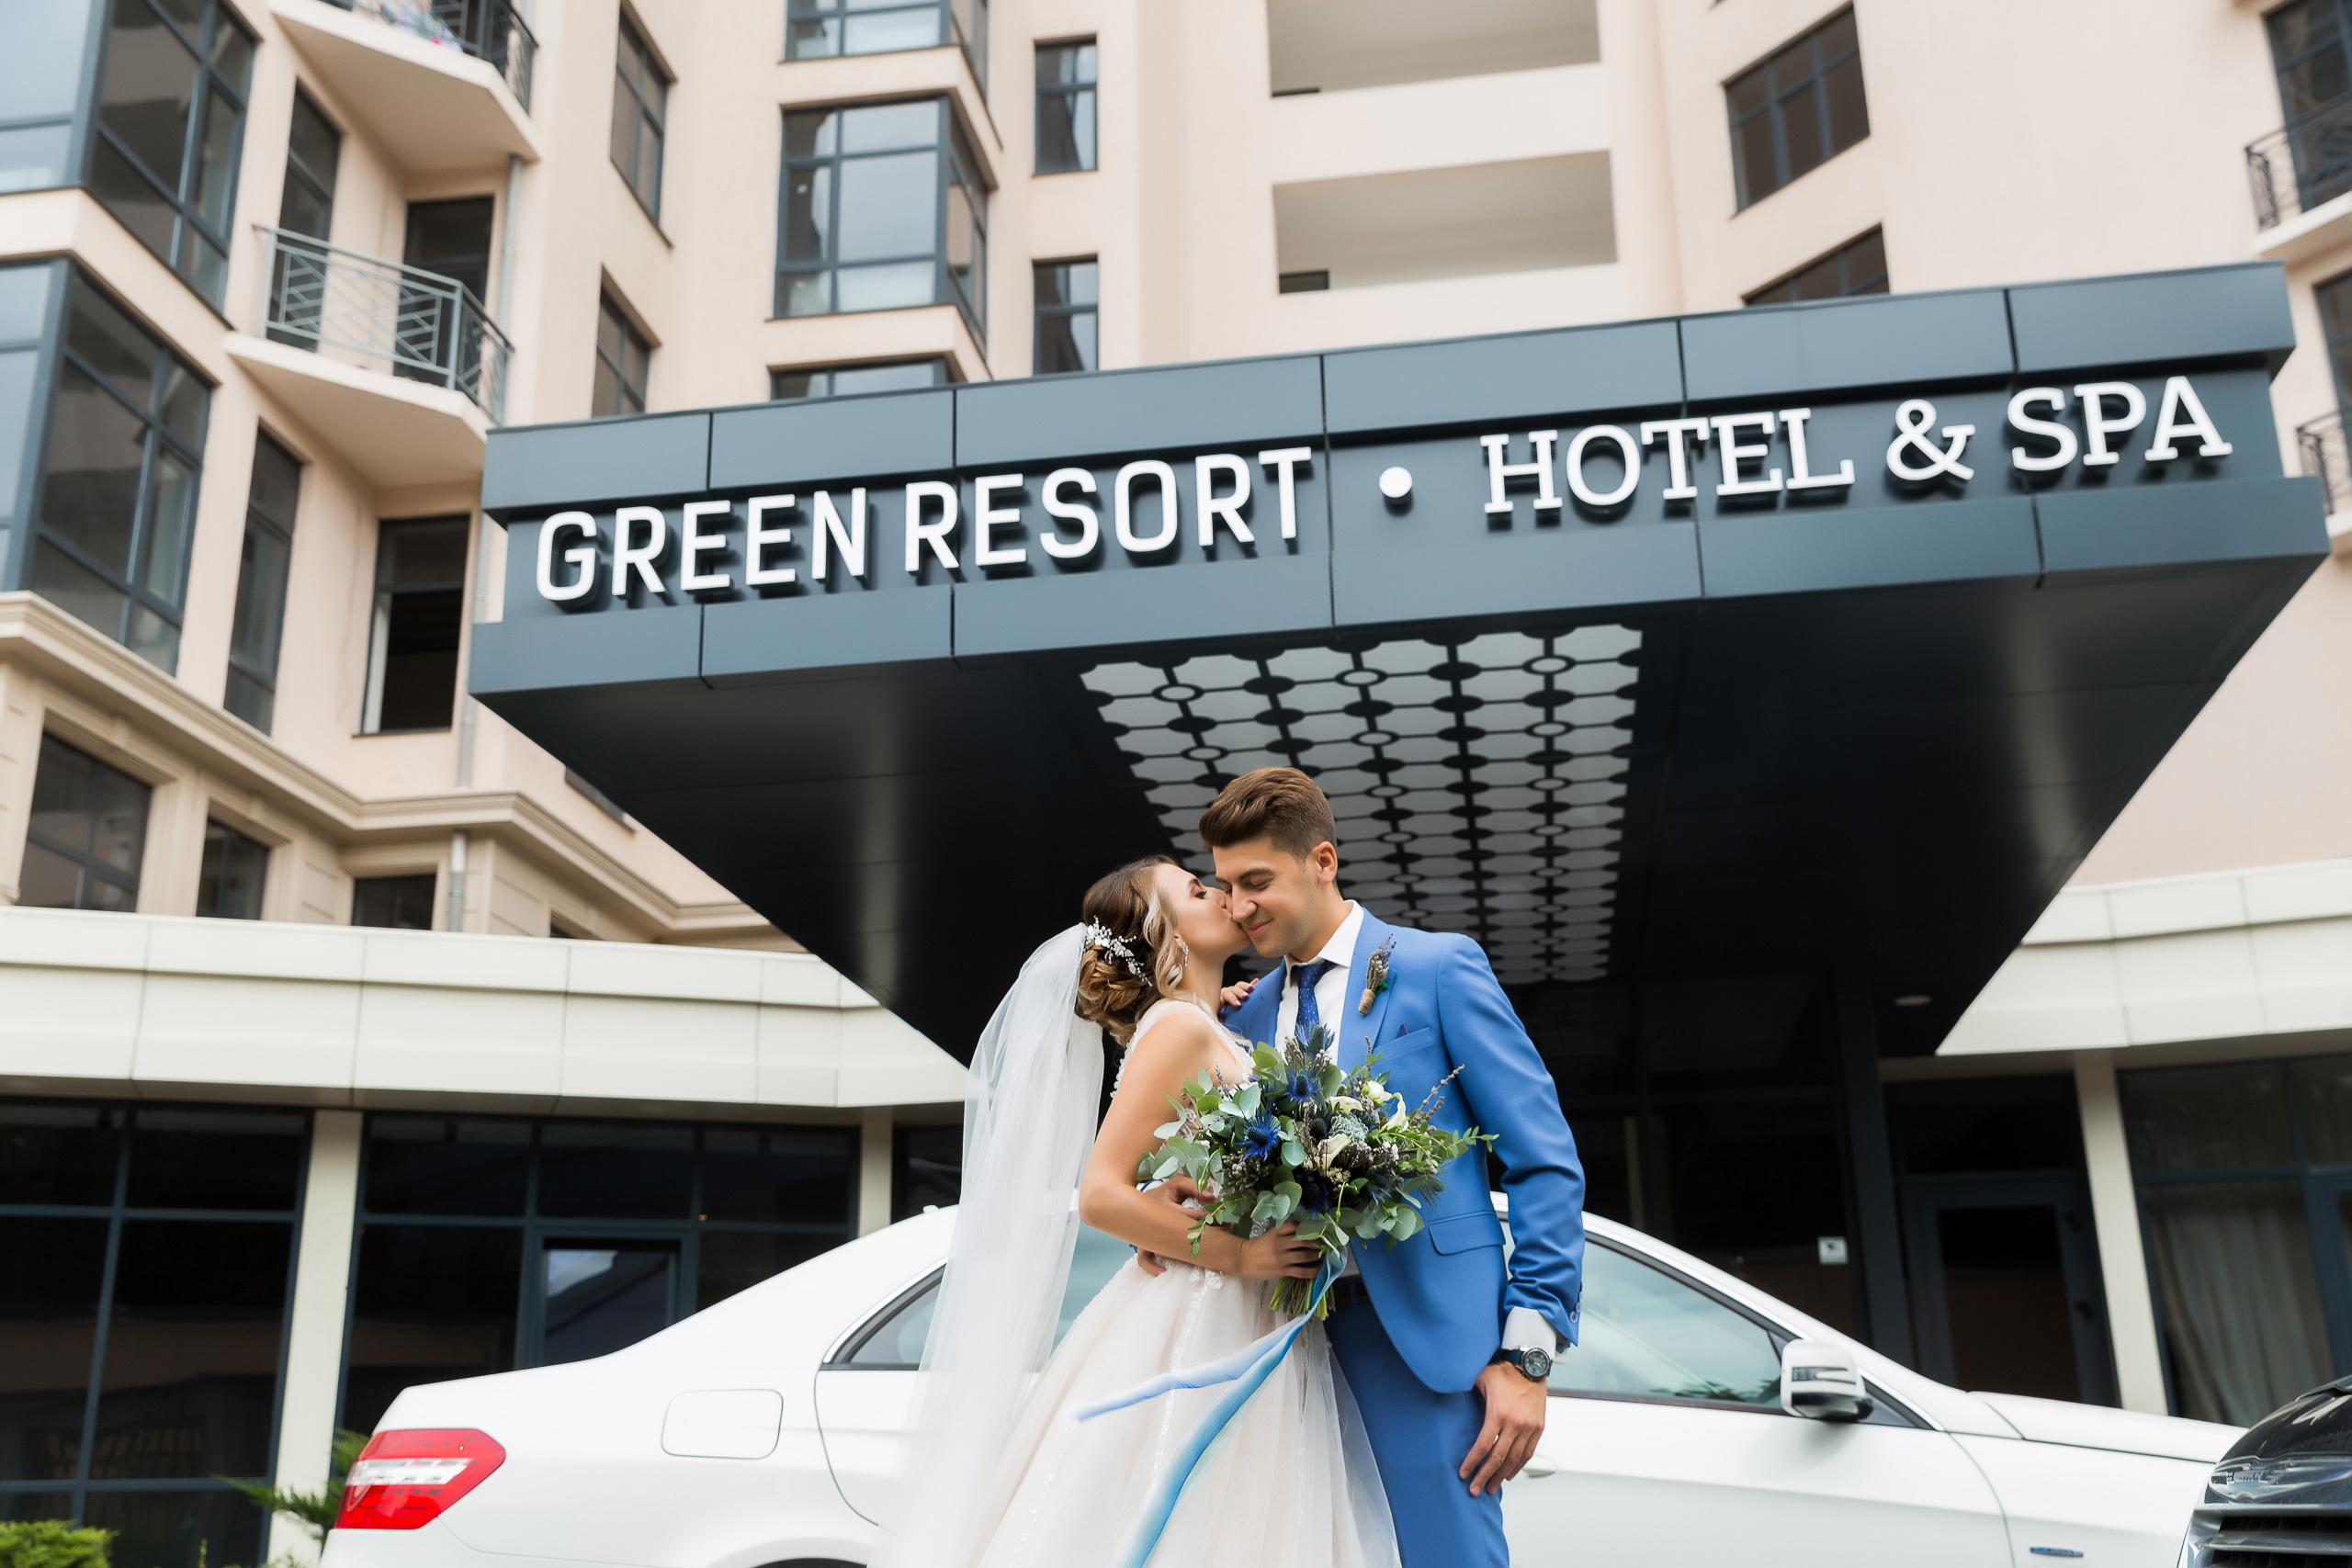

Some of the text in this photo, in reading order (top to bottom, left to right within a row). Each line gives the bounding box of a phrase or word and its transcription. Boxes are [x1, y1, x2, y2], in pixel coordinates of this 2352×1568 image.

[536, 377, 2233, 601] GREEN RESORT HOTEL & SPA
